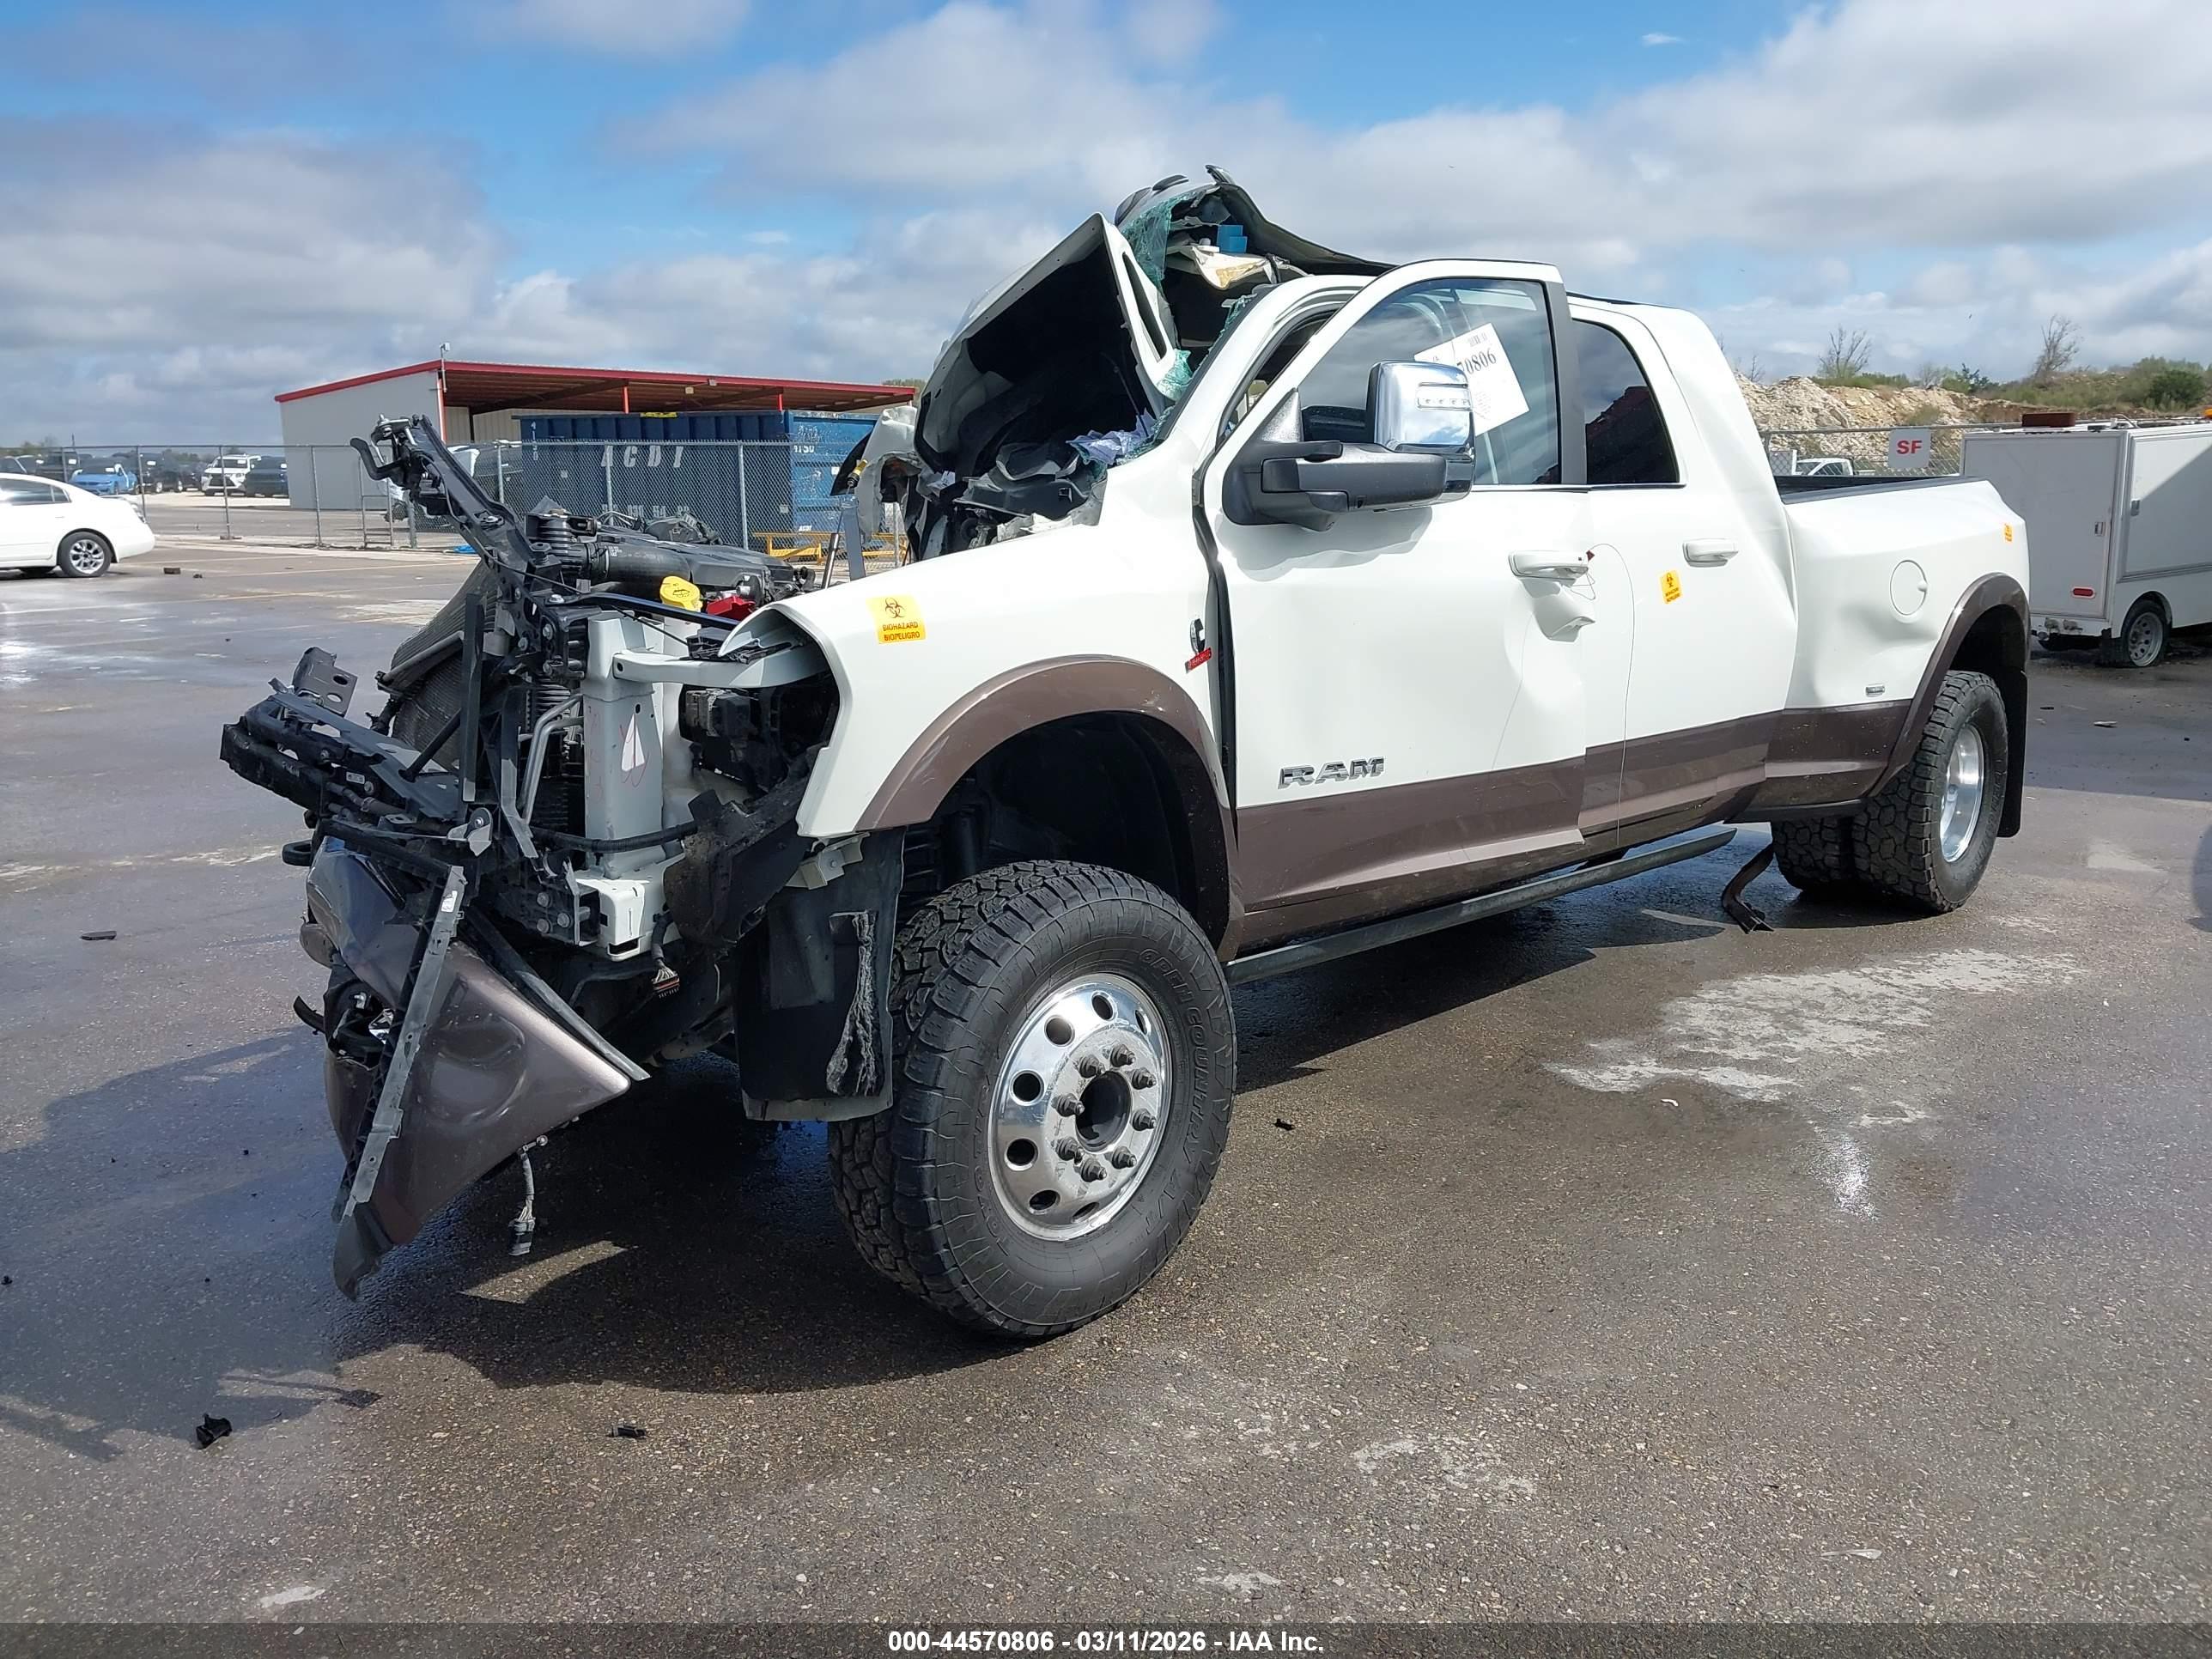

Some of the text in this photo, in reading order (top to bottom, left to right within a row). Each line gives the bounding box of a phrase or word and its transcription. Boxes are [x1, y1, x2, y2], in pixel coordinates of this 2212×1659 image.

[1896, 440, 1923, 454] SF
[882, 622, 918, 631] BIOHAZARD
[884, 631, 920, 641] BIOPELIGRO
[1278, 757, 1384, 789] RAM
[1139, 948, 1194, 1004] OPEN
[1182, 1006, 1209, 1164] COUNTRY
